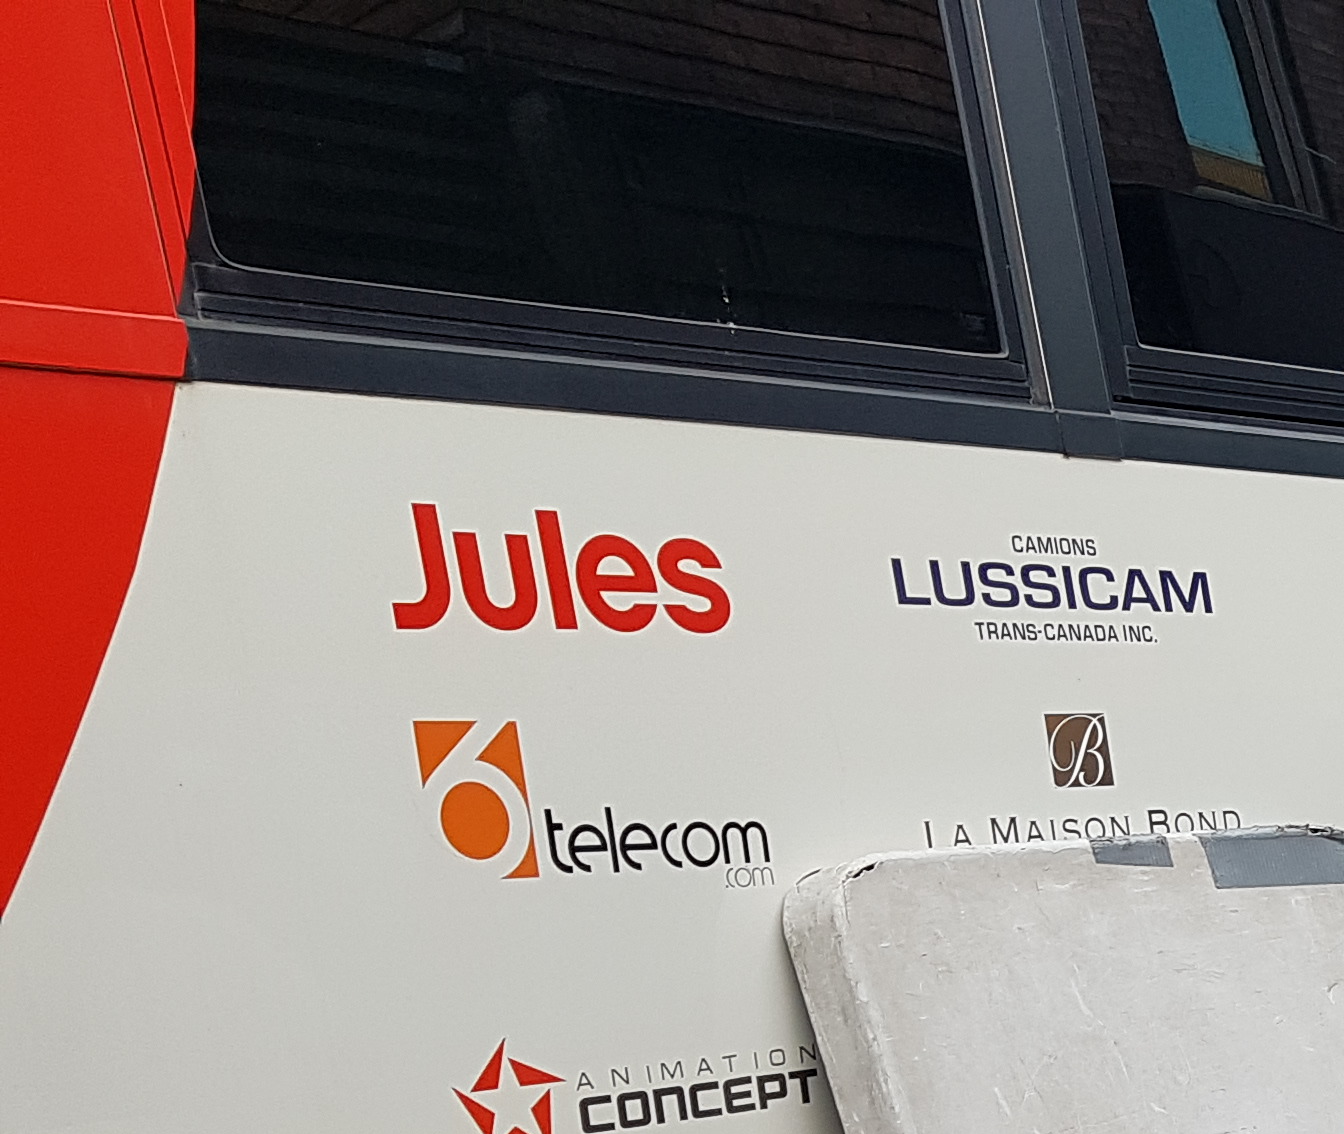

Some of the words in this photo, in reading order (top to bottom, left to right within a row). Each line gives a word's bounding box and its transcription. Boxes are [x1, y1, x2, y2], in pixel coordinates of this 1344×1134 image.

[392, 502, 731, 634] Jules
[1011, 534, 1097, 556] CAMIONS
[890, 557, 1214, 614] LUSSICAM
[974, 621, 1120, 643] TRANS-CANADA
[1121, 624, 1159, 643] INC.
[543, 806, 773, 874] telecom
[576, 1042, 818, 1092] ANIMATION
[579, 1067, 818, 1134] CONCEPT
